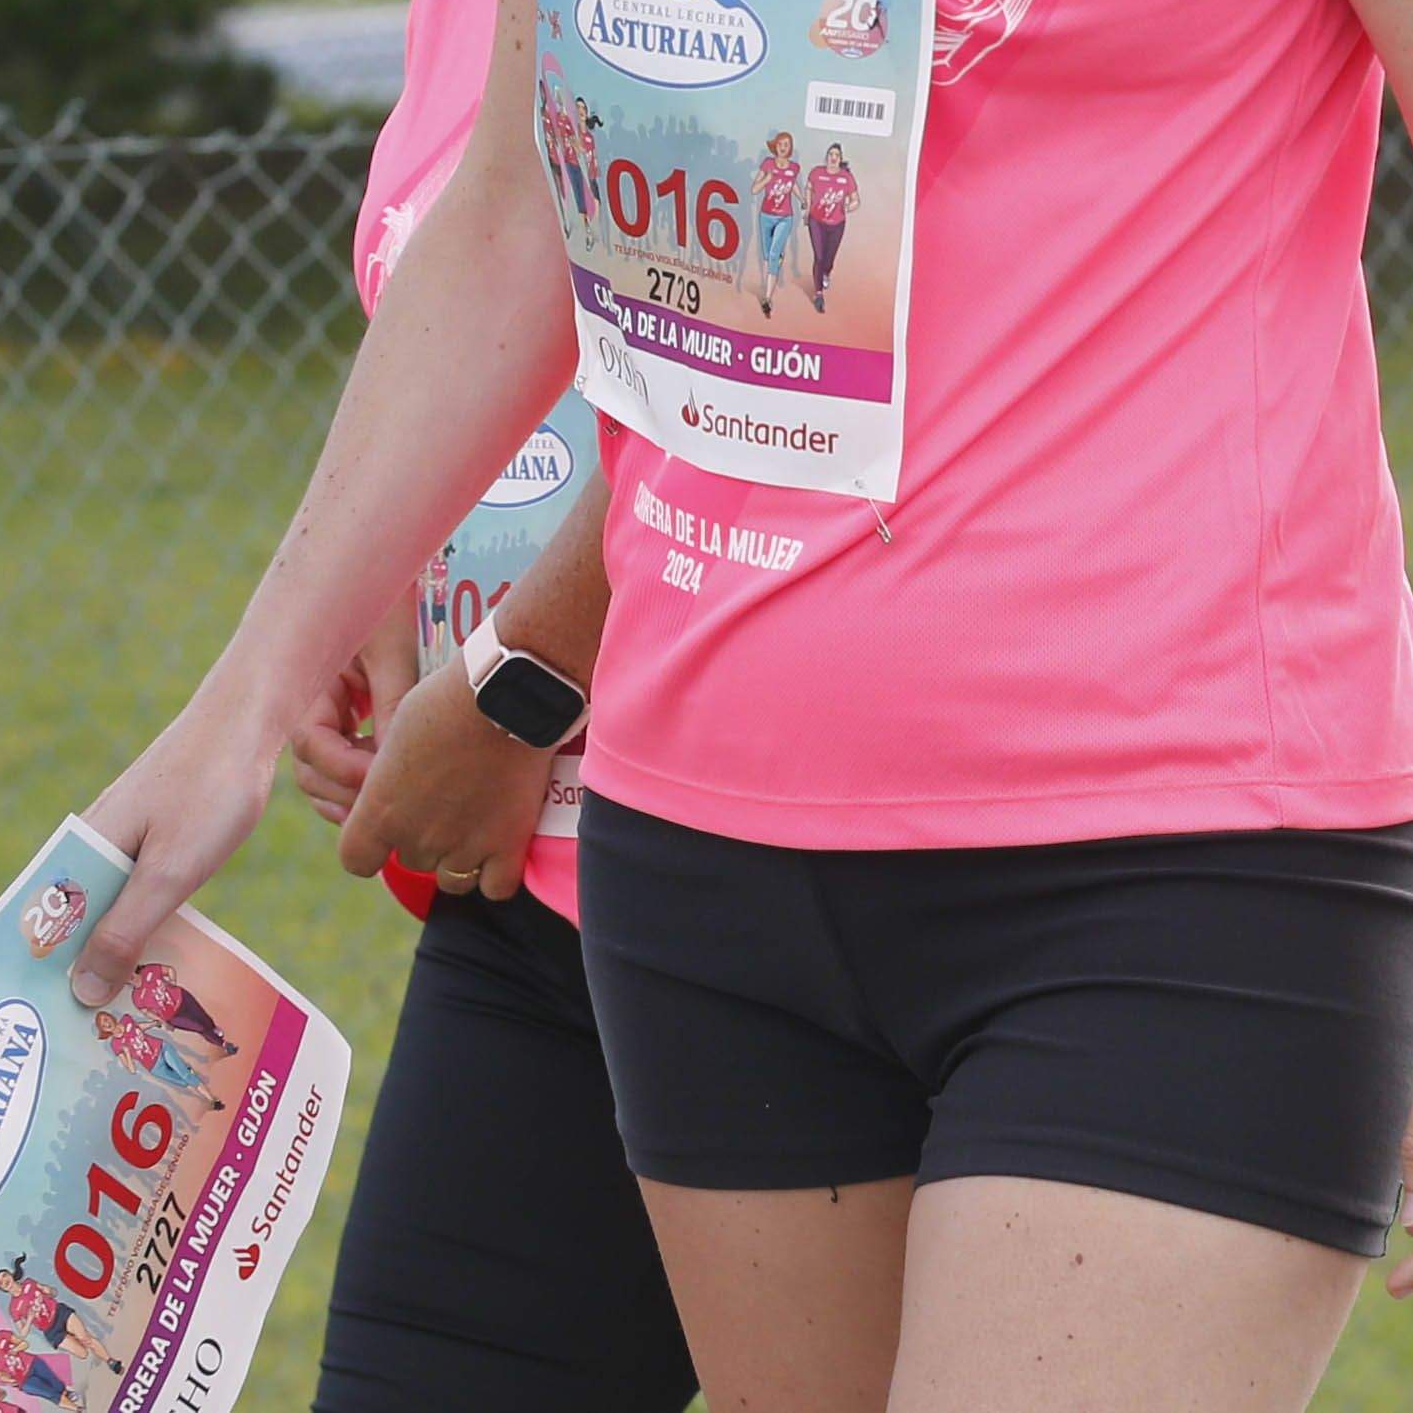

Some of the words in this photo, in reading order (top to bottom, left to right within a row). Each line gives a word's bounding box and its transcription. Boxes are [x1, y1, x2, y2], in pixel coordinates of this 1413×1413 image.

[678, 8, 745, 28] LECHERA
[606, 158, 740, 260] 016
[647, 267, 700, 314] 2729
[638, 311, 656, 342] DE
[660, 318, 677, 349] LA
[681, 327, 732, 366] MUJER
[751, 344, 821, 381] GIJÓN
[702, 405, 839, 455] Santander
[662, 548, 704, 595] 2024
[675, 508, 695, 548] DE
[700, 518, 722, 558] LA
[727, 526, 804, 571] MUJER
[54, 1091, 173, 1299] 016
[251, 1084, 323, 1242] Santander
[118, 1336, 171, 1413] RRERA
[158, 1293, 186, 1333] DE
[172, 1258, 199, 1293] LA
[188, 1165, 241, 1255] MUJER
[238, 1069, 278, 1147] GIJÓN
[136, 1191, 186, 1295] 2727
